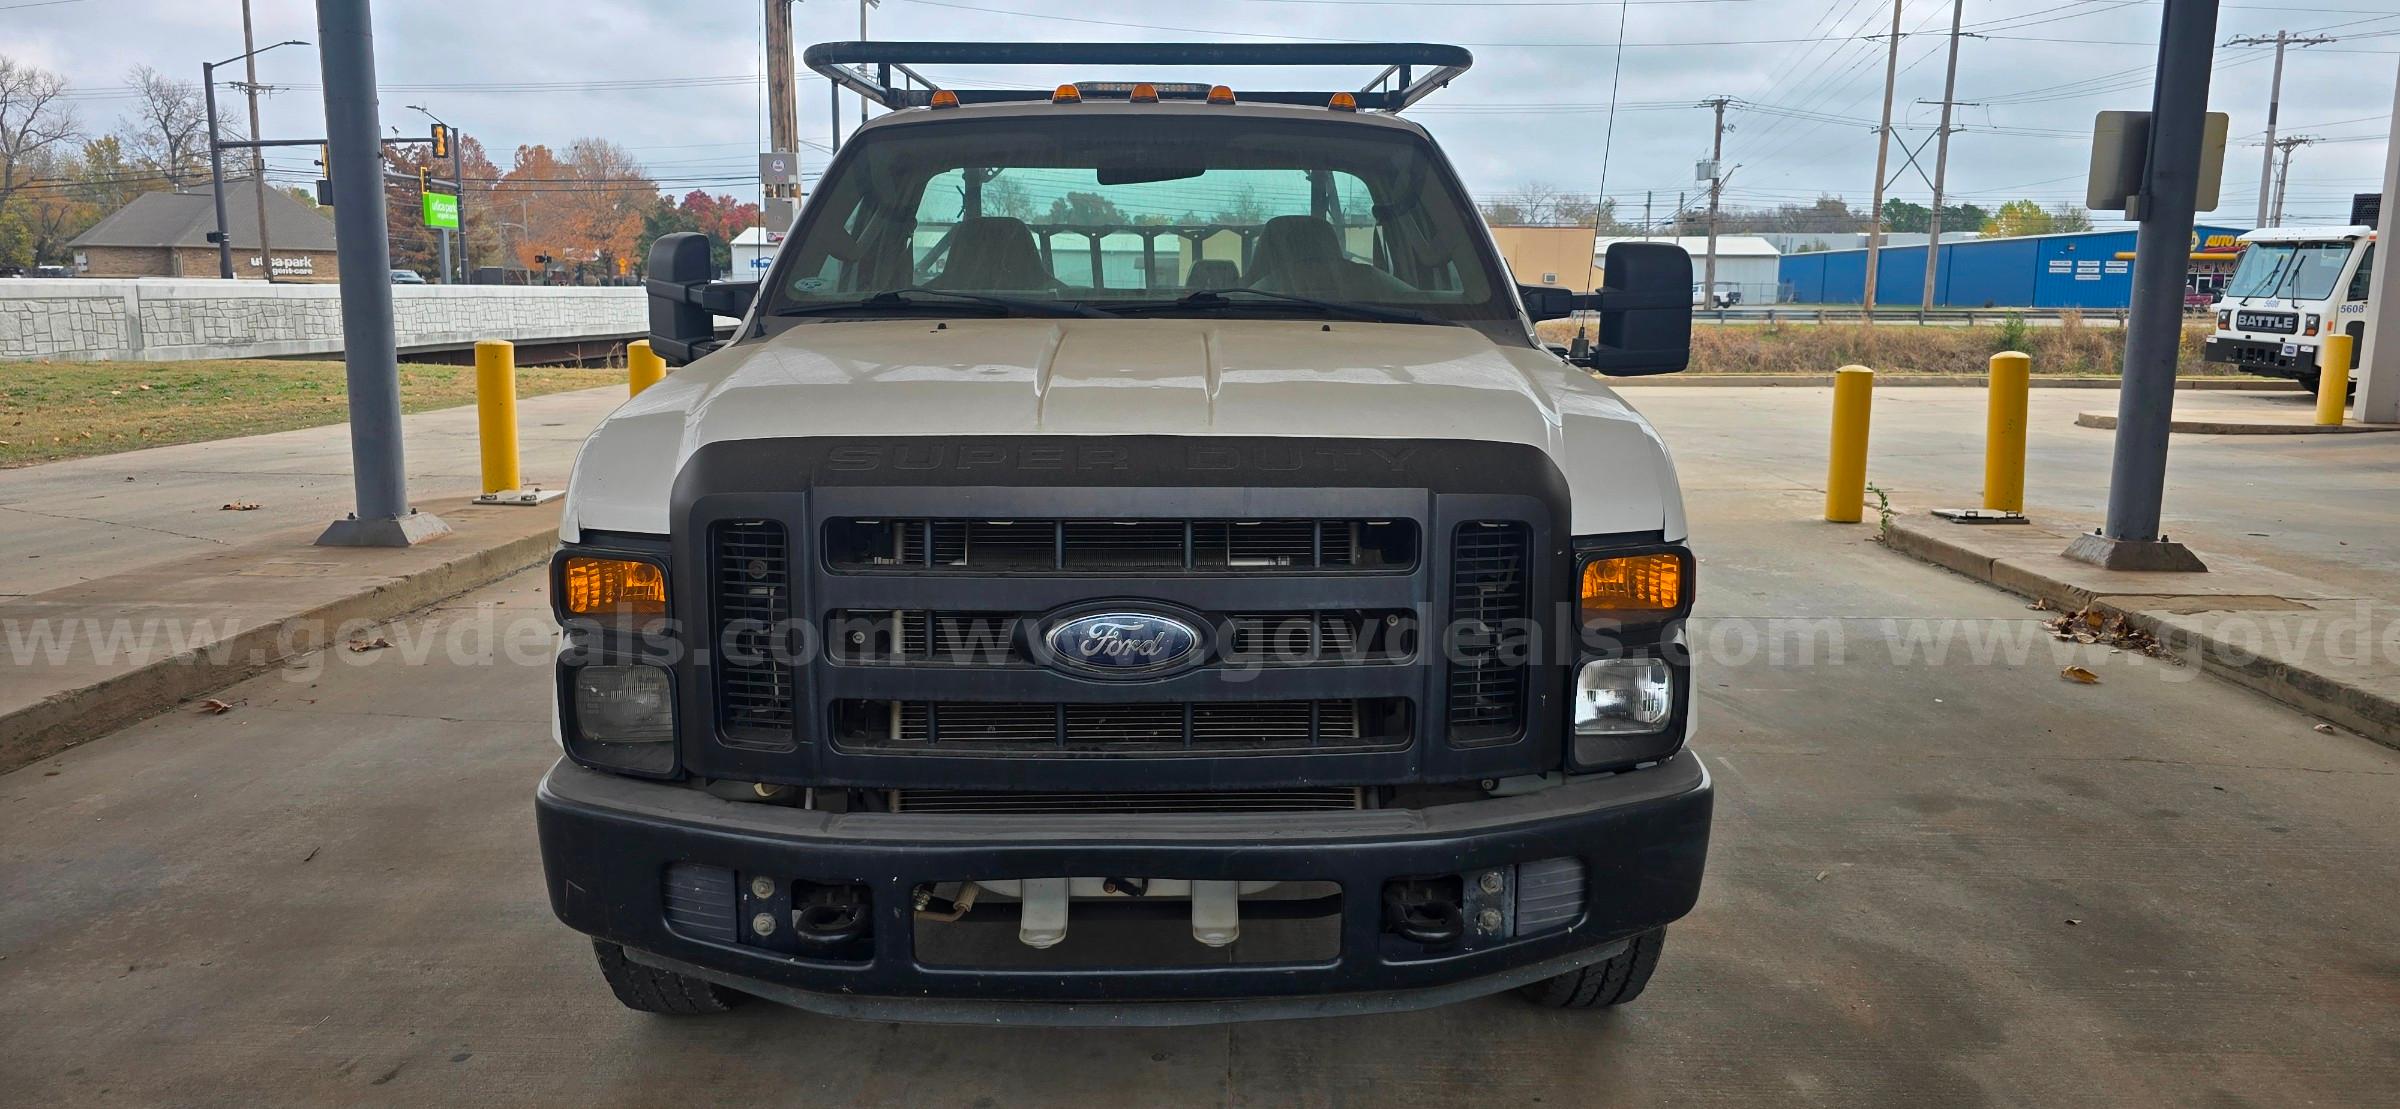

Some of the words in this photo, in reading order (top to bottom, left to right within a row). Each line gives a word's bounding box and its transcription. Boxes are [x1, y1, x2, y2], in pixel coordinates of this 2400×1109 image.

[2205, 235, 2235, 247] AUTO
[284, 255, 312, 269] park
[2340, 304, 2364, 313] 5608
[2237, 314, 2295, 329] BATTLE
[828, 446, 1129, 471] SUPER
[1184, 446, 1418, 471] DUTY
[1080, 622, 1165, 657] Ford
